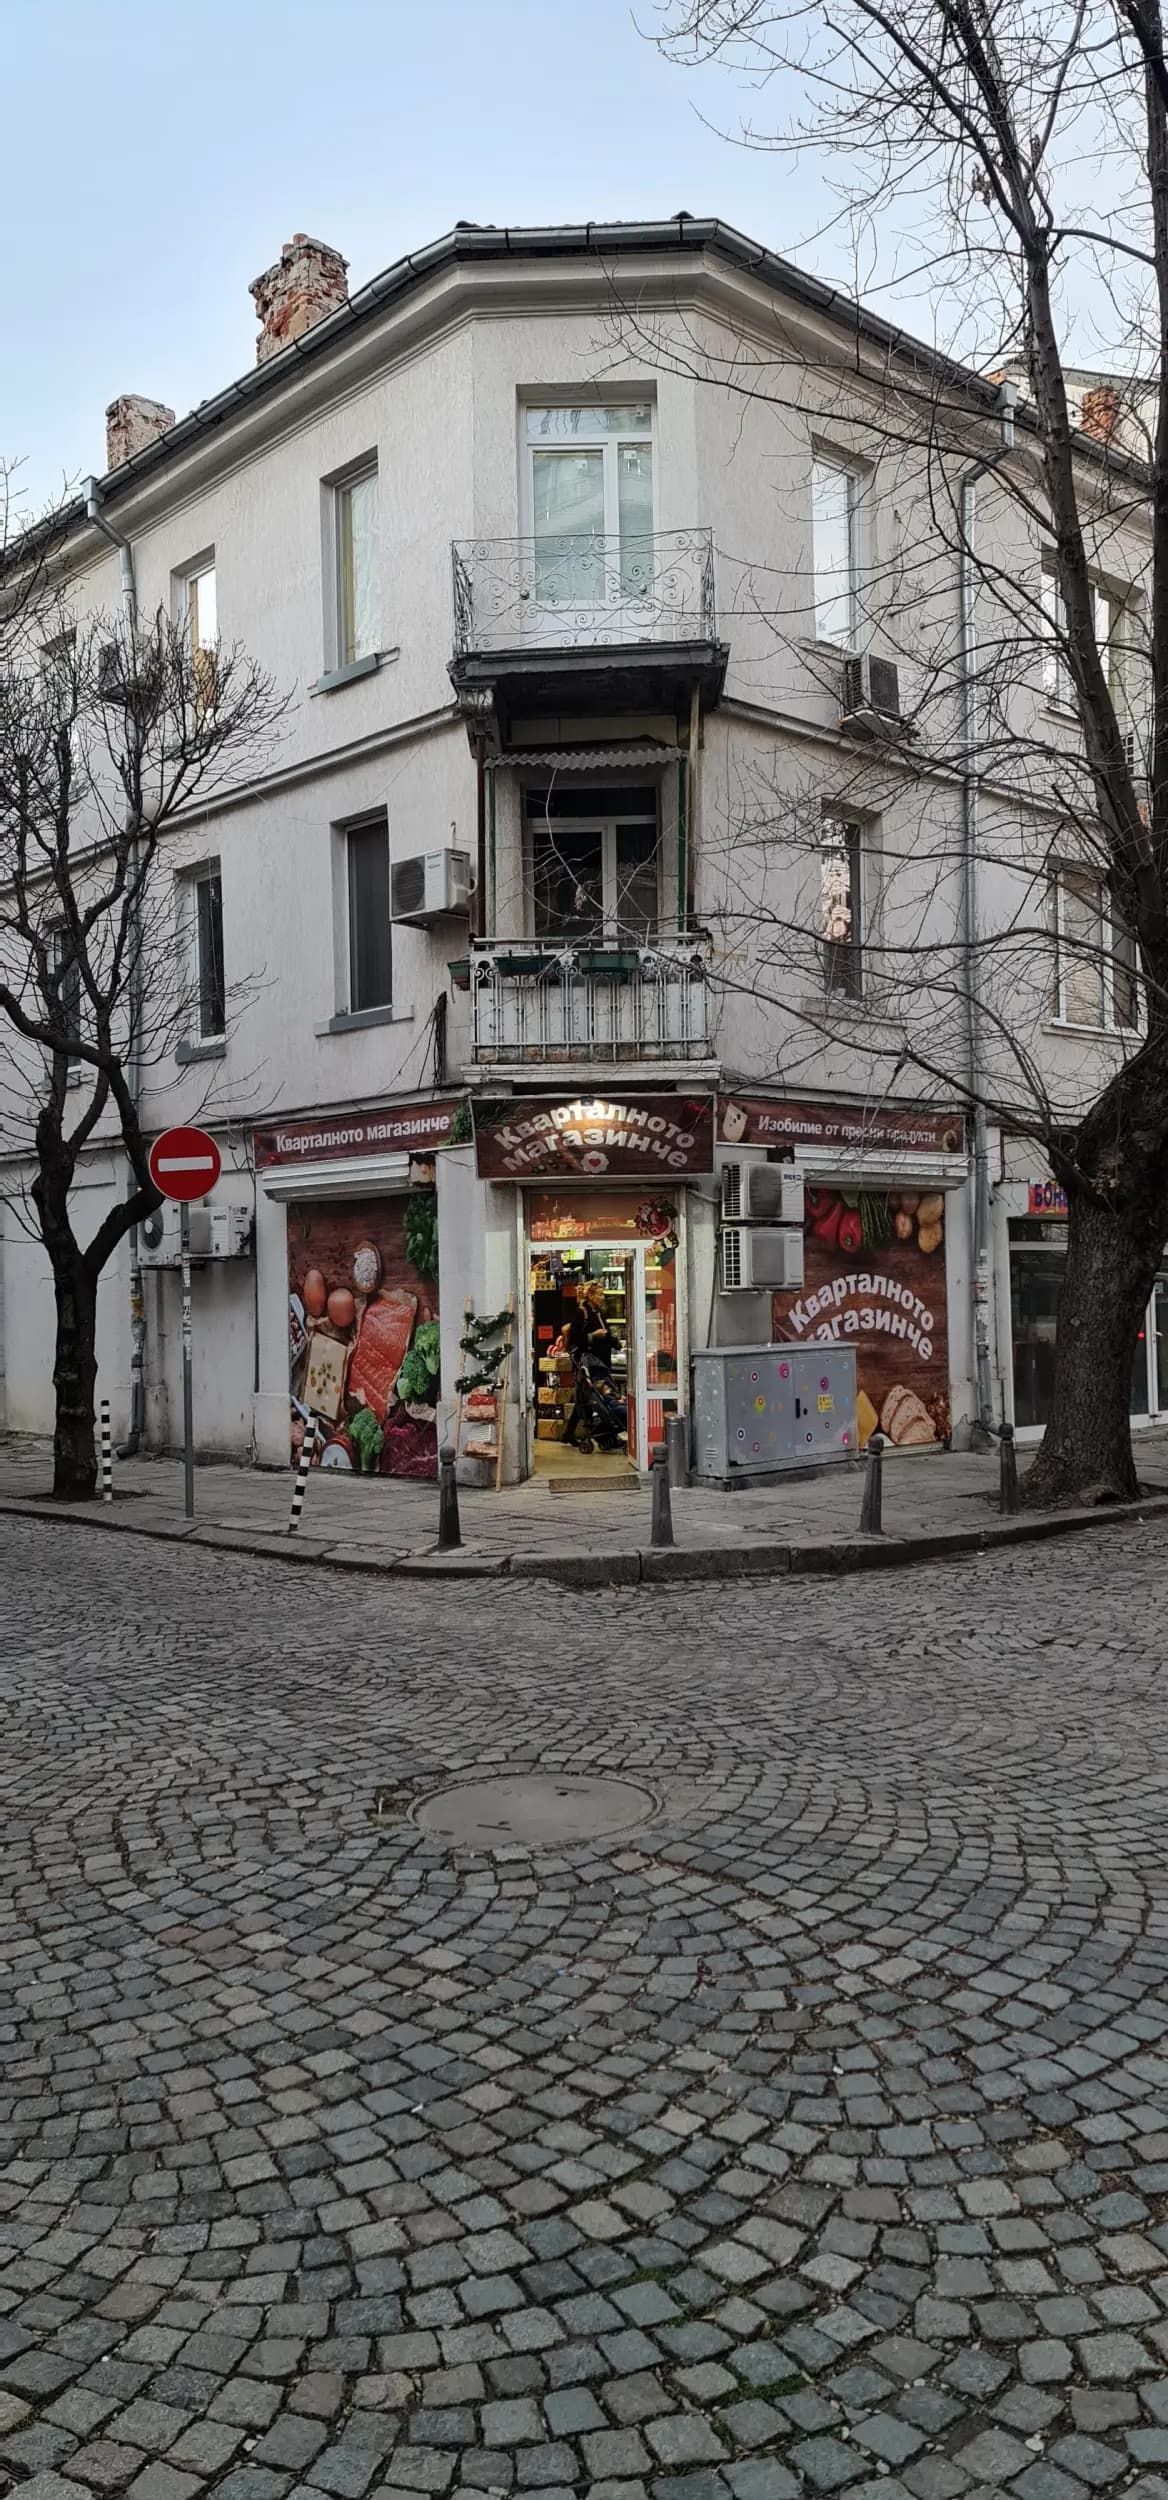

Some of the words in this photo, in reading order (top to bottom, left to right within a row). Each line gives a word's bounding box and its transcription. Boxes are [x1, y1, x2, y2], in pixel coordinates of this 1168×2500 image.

[276, 1128, 364, 1153] Кварталното
[367, 1115, 450, 1141] магазинче
[494, 1099, 695, 1150] Кварталното
[758, 1115, 823, 1135] Изобилие
[825, 1122, 837, 1136] от
[502, 1128, 688, 1171] магазинче
[788, 1273, 934, 1333] Кварталното
[806, 1308, 933, 1360] агазинче
